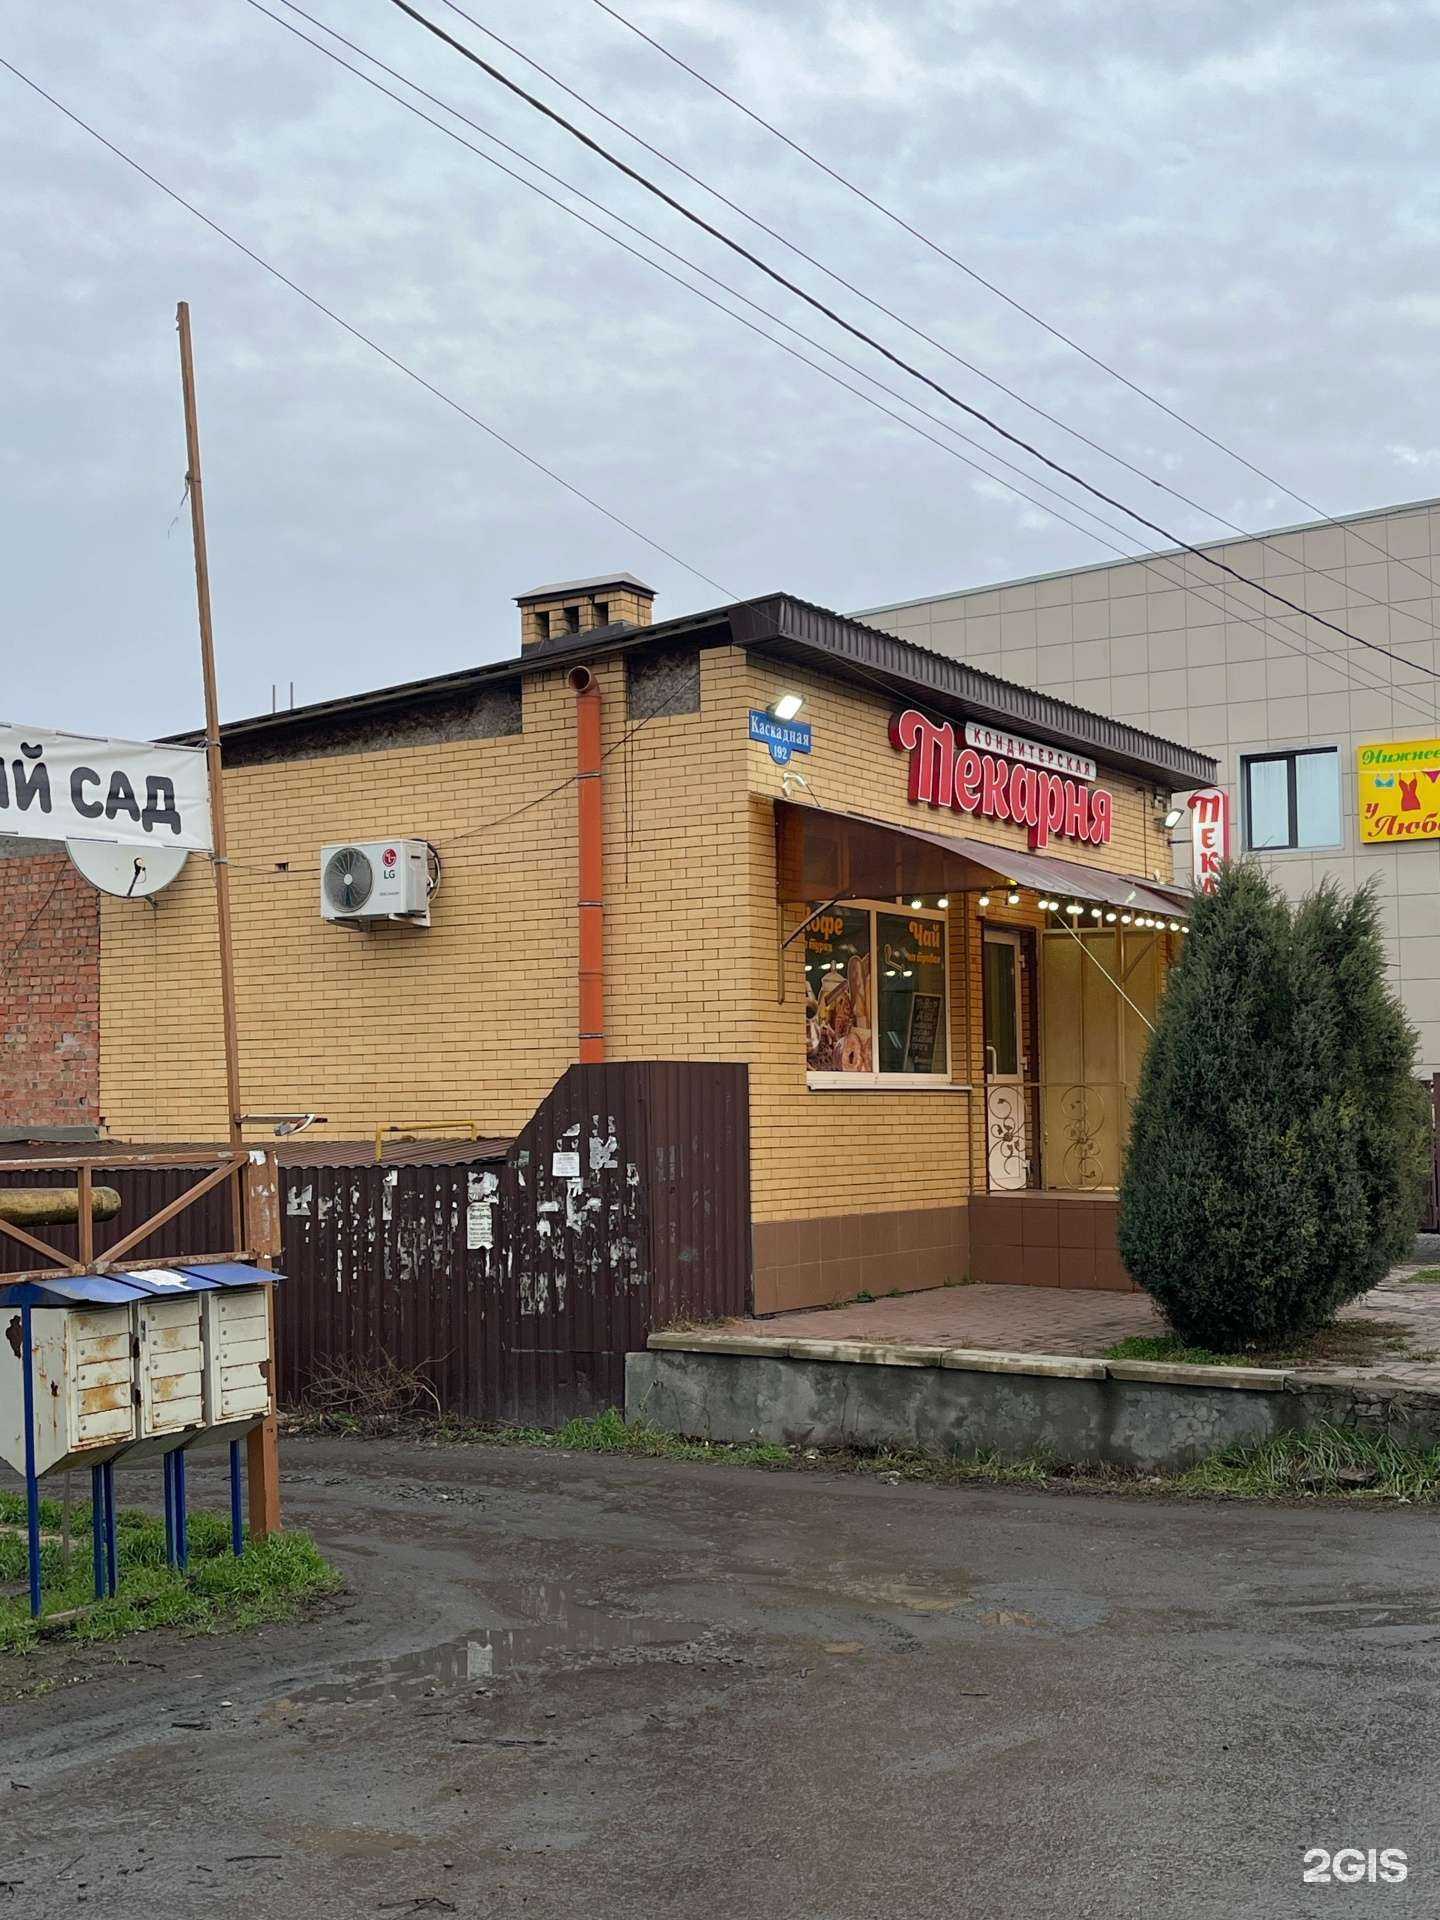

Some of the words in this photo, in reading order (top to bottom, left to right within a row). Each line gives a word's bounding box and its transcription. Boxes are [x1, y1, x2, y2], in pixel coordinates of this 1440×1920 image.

[751, 715, 810, 746] Каскадная
[773, 744, 788, 760] 192
[973, 726, 1092, 776] КОНДИТЕРСКАЯ
[895, 709, 1113, 849] Пекарня
[70, 766, 182, 835] САД
[1368, 812, 1440, 837] Люб
[383, 869, 396, 880] LG
[908, 920, 940, 948] Чай
